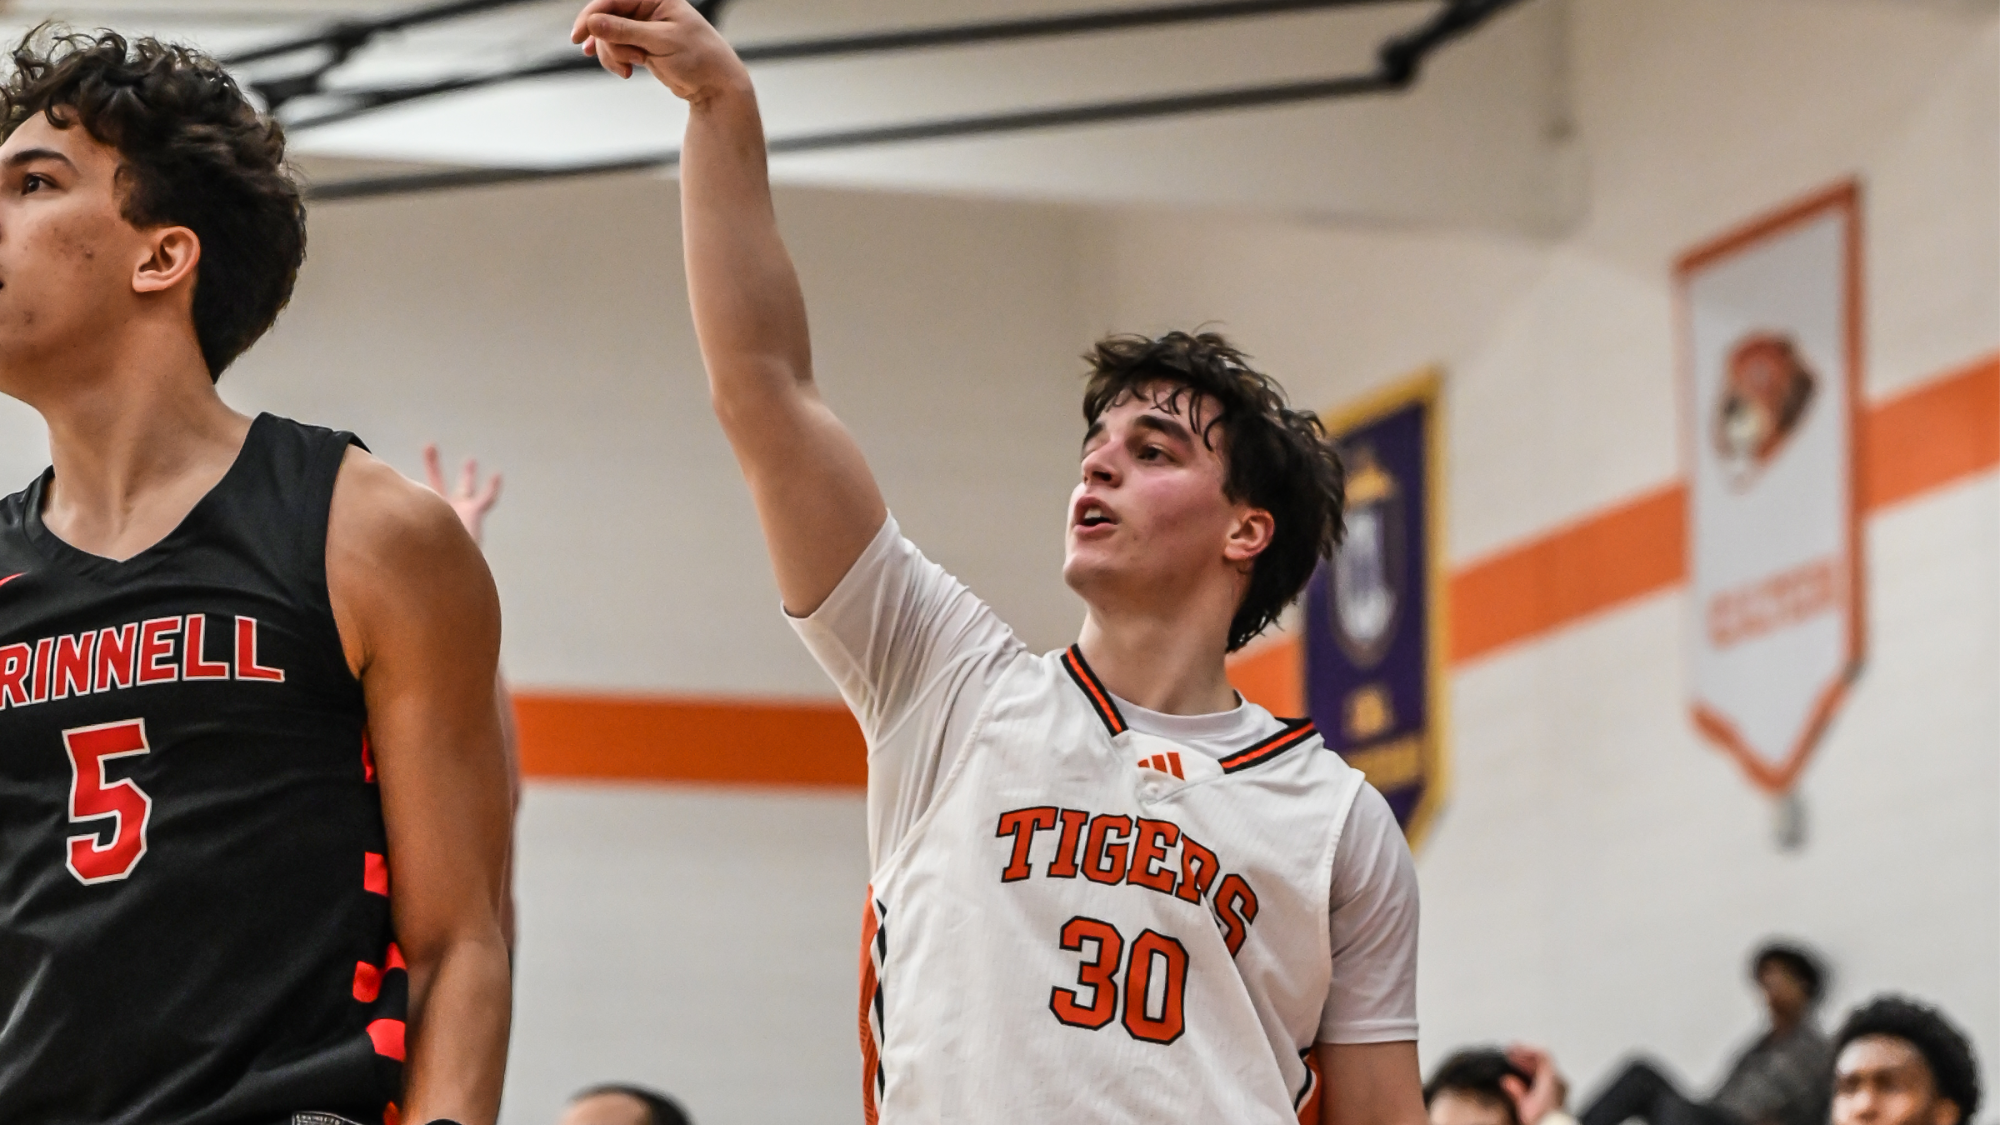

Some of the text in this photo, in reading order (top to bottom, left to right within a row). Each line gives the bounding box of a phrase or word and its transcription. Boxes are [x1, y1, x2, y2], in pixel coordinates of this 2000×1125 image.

[62, 717, 152, 885] 5
[995, 806, 1259, 958] TIGERS
[1050, 915, 1189, 1046] 30
